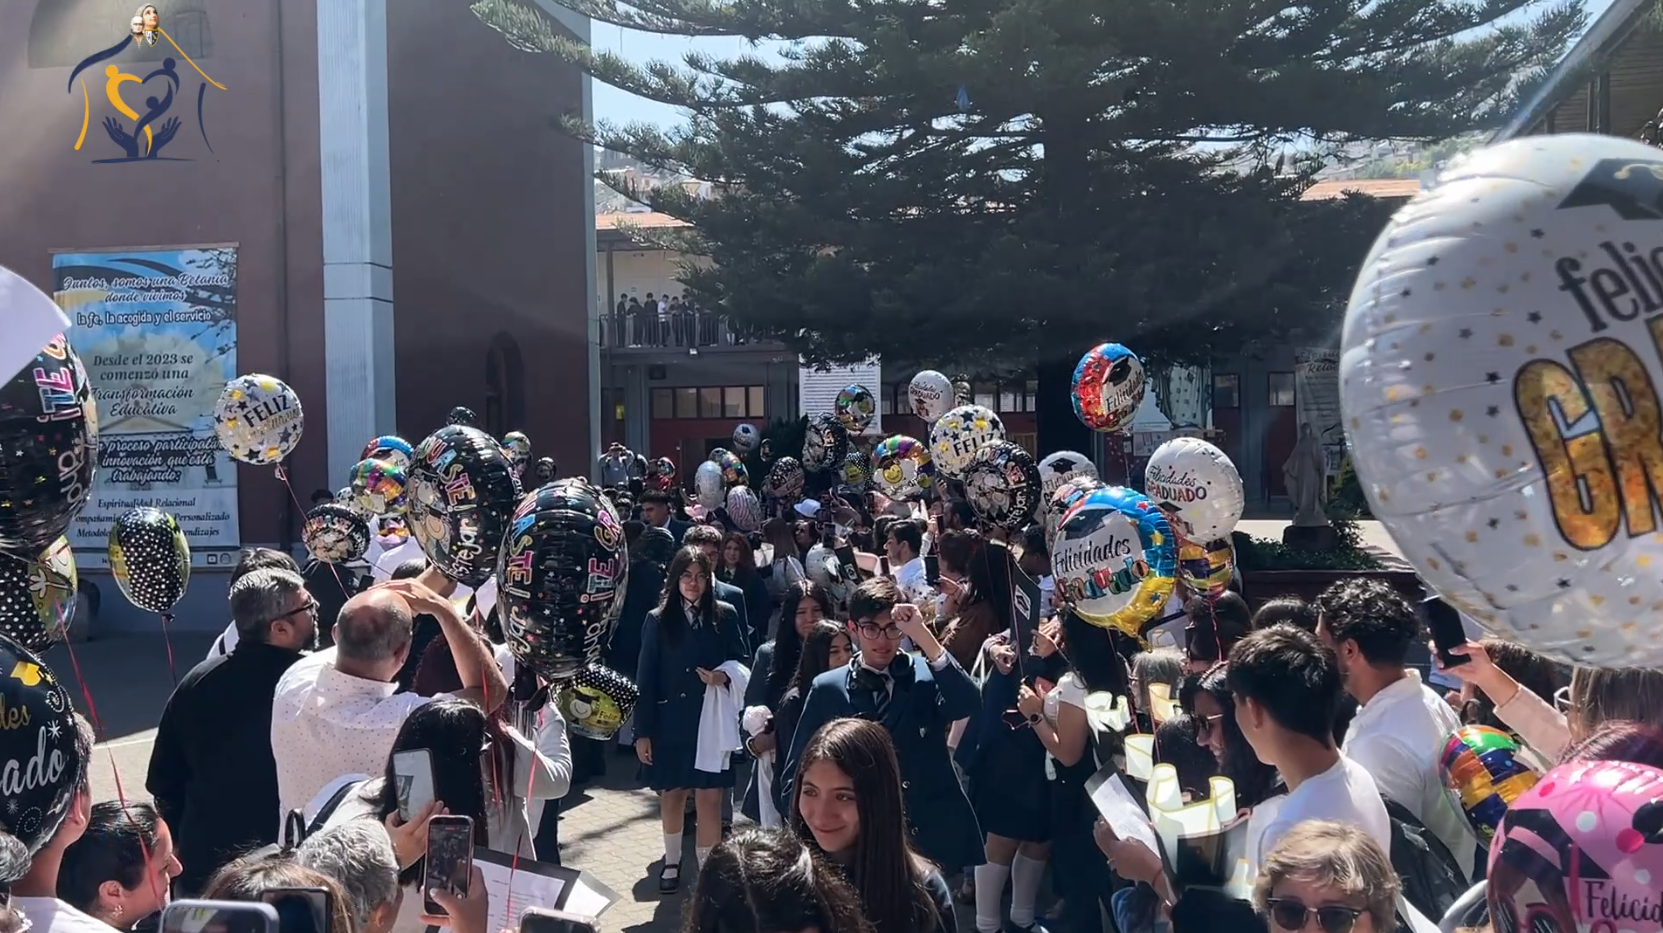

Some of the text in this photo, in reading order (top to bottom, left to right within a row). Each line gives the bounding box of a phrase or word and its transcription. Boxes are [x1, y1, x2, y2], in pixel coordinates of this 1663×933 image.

[111, 276, 150, 289] somos
[152, 276, 177, 288] una
[104, 288, 188, 303] donde vivimos
[106, 310, 116, 325] la
[117, 310, 152, 327] acogida
[154, 313, 162, 326] y
[163, 310, 174, 323] el
[175, 309, 213, 322] servicio
[93, 353, 194, 367] Desde el 2023 se
[100, 368, 189, 381] comenzó una
[91, 386, 195, 402] Transformación
[109, 401, 178, 417] Educativa
[243, 395, 291, 428] FELIZ
[107, 439, 151, 454] proceso
[101, 452, 164, 468] innovación
[166, 454, 188, 468] que
[111, 469, 182, 487] trabajando:
[155, 497, 196, 508] Relacional
[174, 512, 230, 523] Personalizado
[1054, 535, 1131, 576] Felicidades
